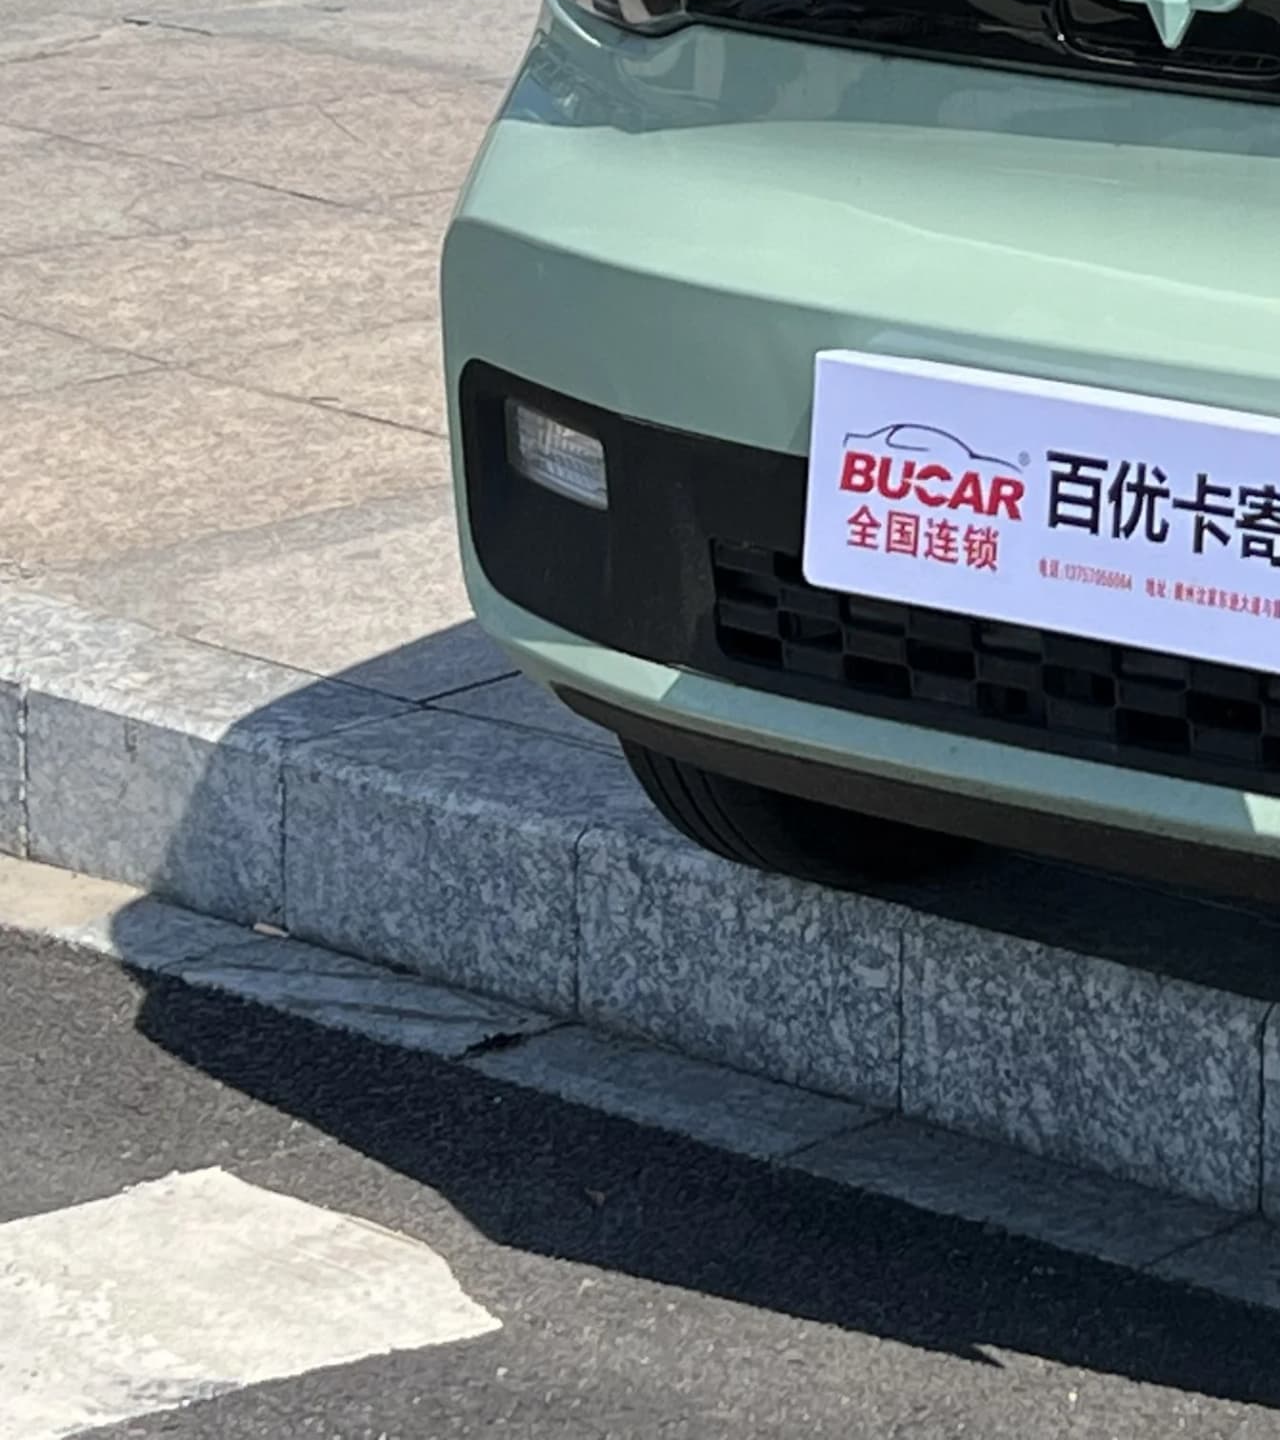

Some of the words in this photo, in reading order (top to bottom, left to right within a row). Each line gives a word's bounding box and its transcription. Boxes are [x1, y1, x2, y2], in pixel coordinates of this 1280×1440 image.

[840, 450, 1025, 522] BUCAR
[847, 504, 999, 572] 全国连锁
